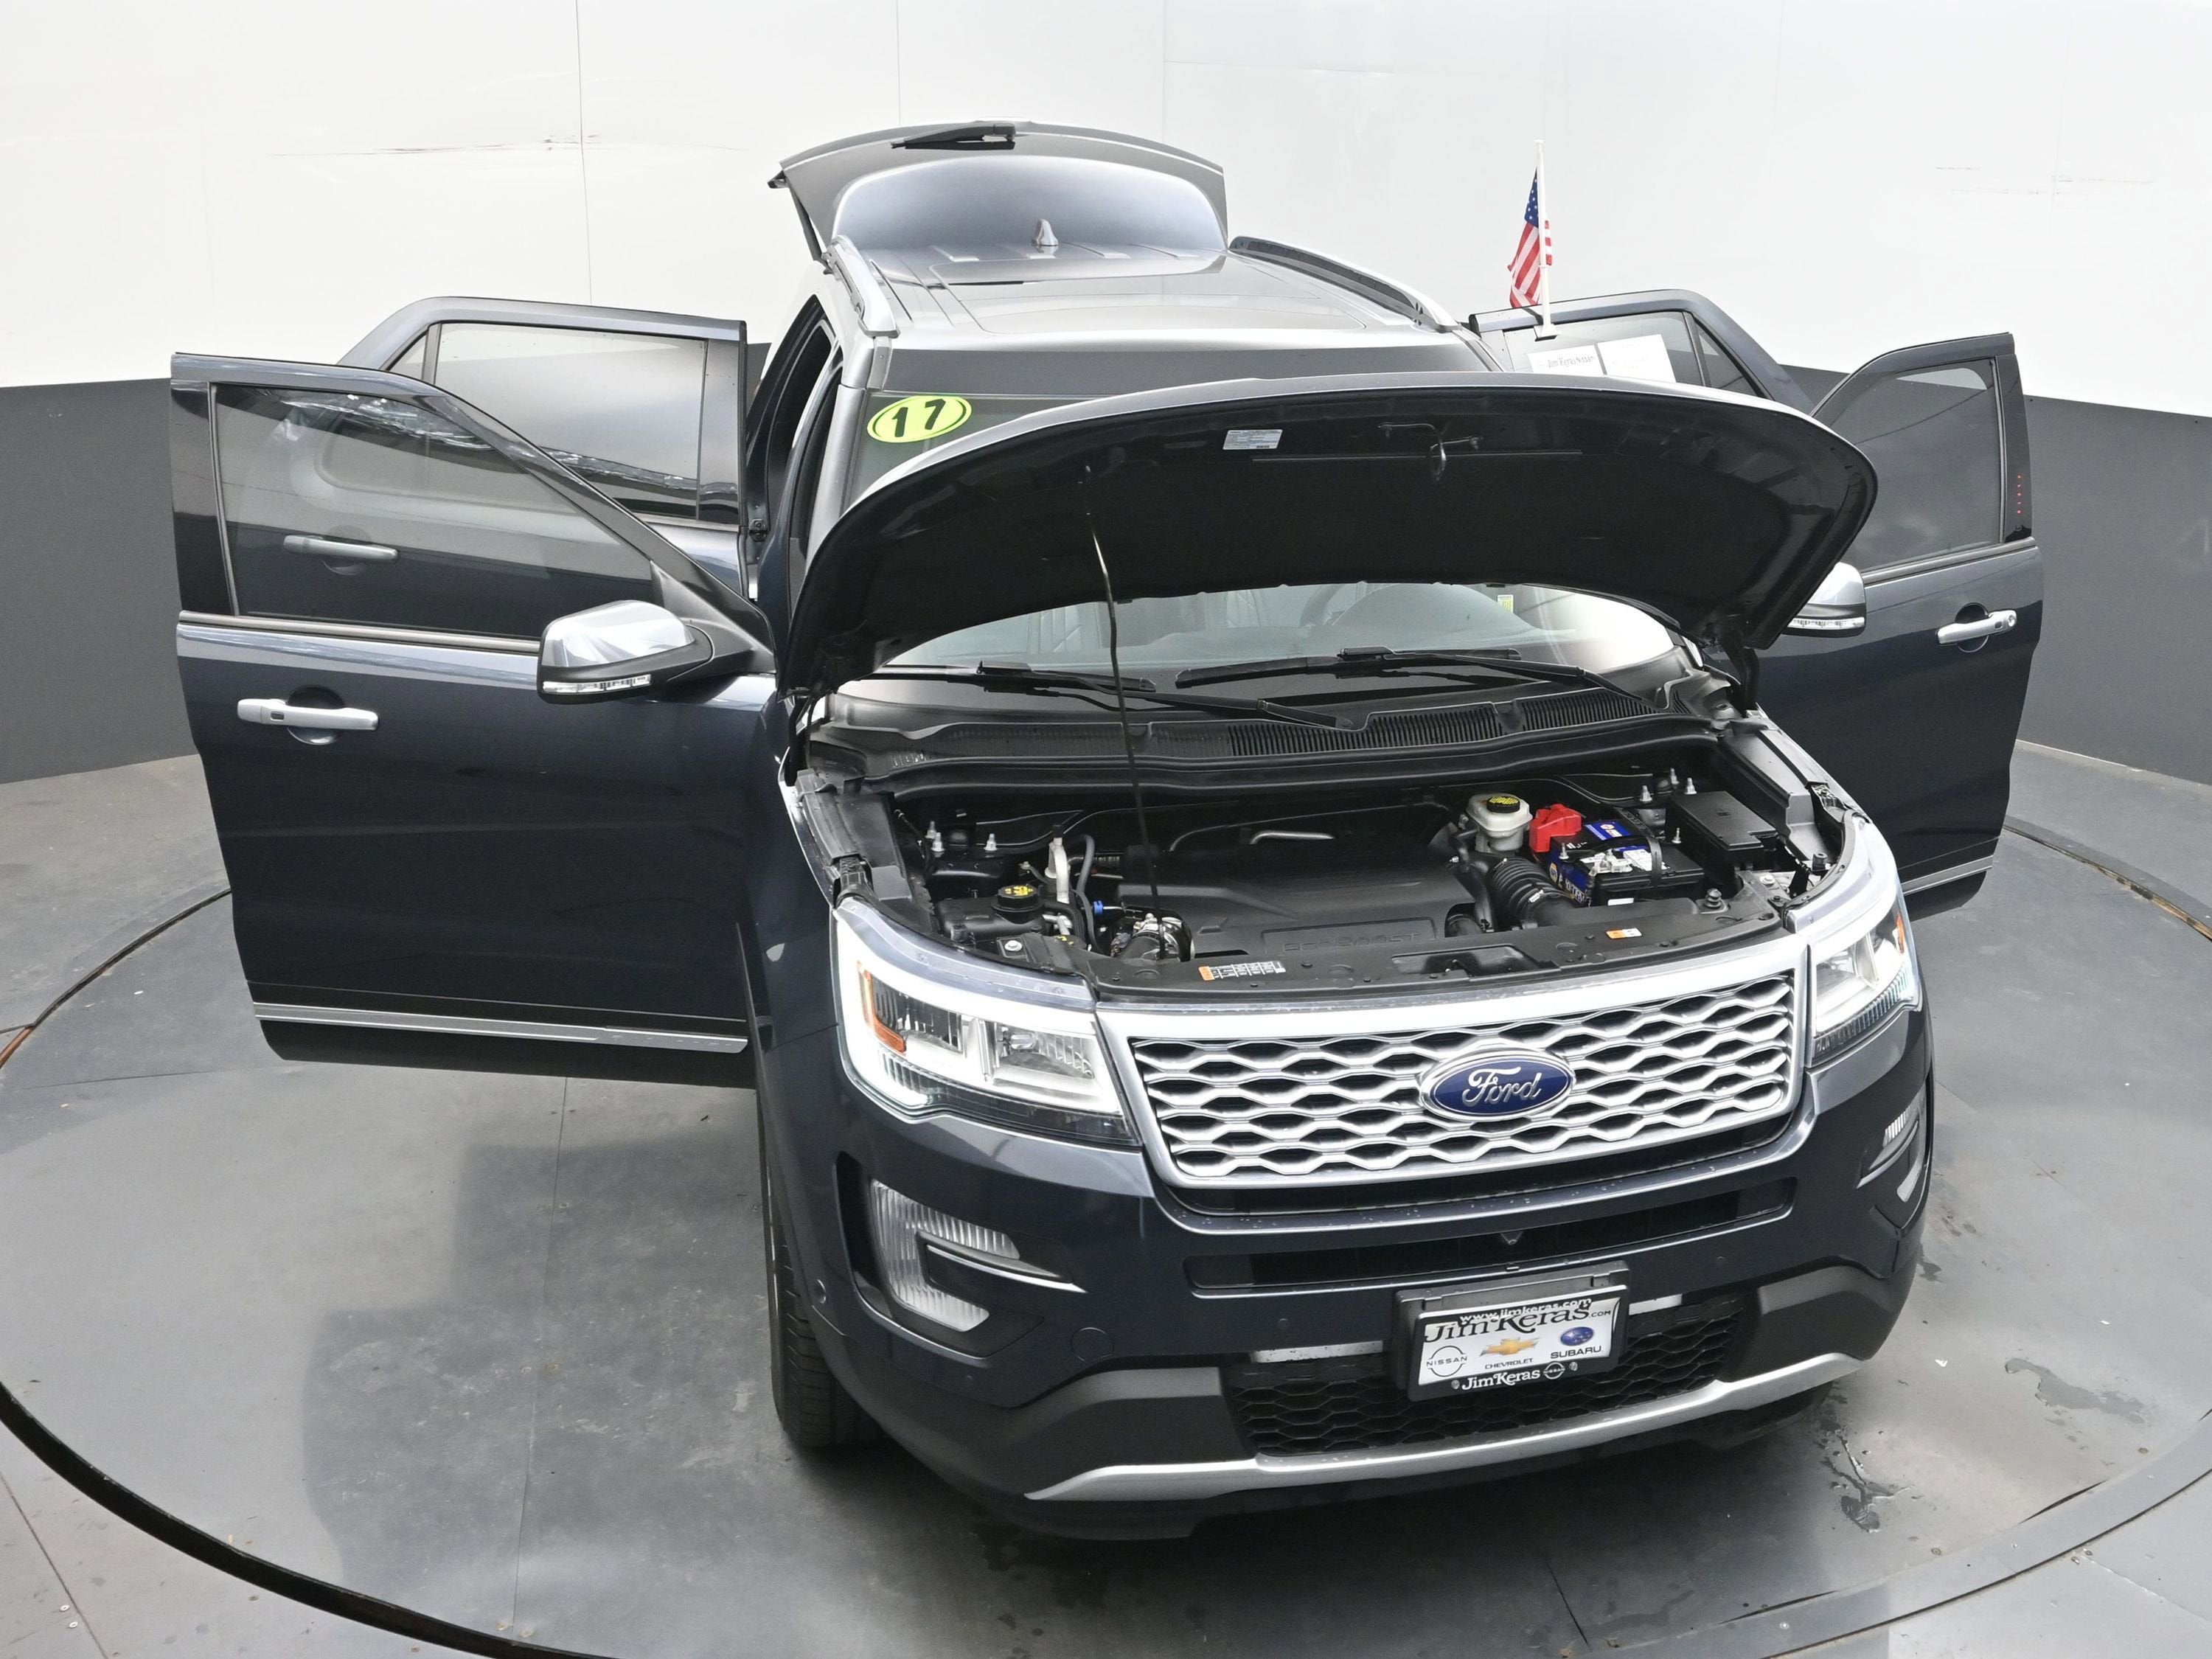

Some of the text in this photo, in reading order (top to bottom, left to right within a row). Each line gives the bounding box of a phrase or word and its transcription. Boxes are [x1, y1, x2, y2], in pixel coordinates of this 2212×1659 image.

[892, 399, 946, 437] 17
[1462, 1067, 1542, 1106] Ford
[1551, 1346, 1601, 1359] SUBARU
[1427, 1357, 1467, 1366] NISSAN
[1485, 1358, 1533, 1370] CHEVROLET
